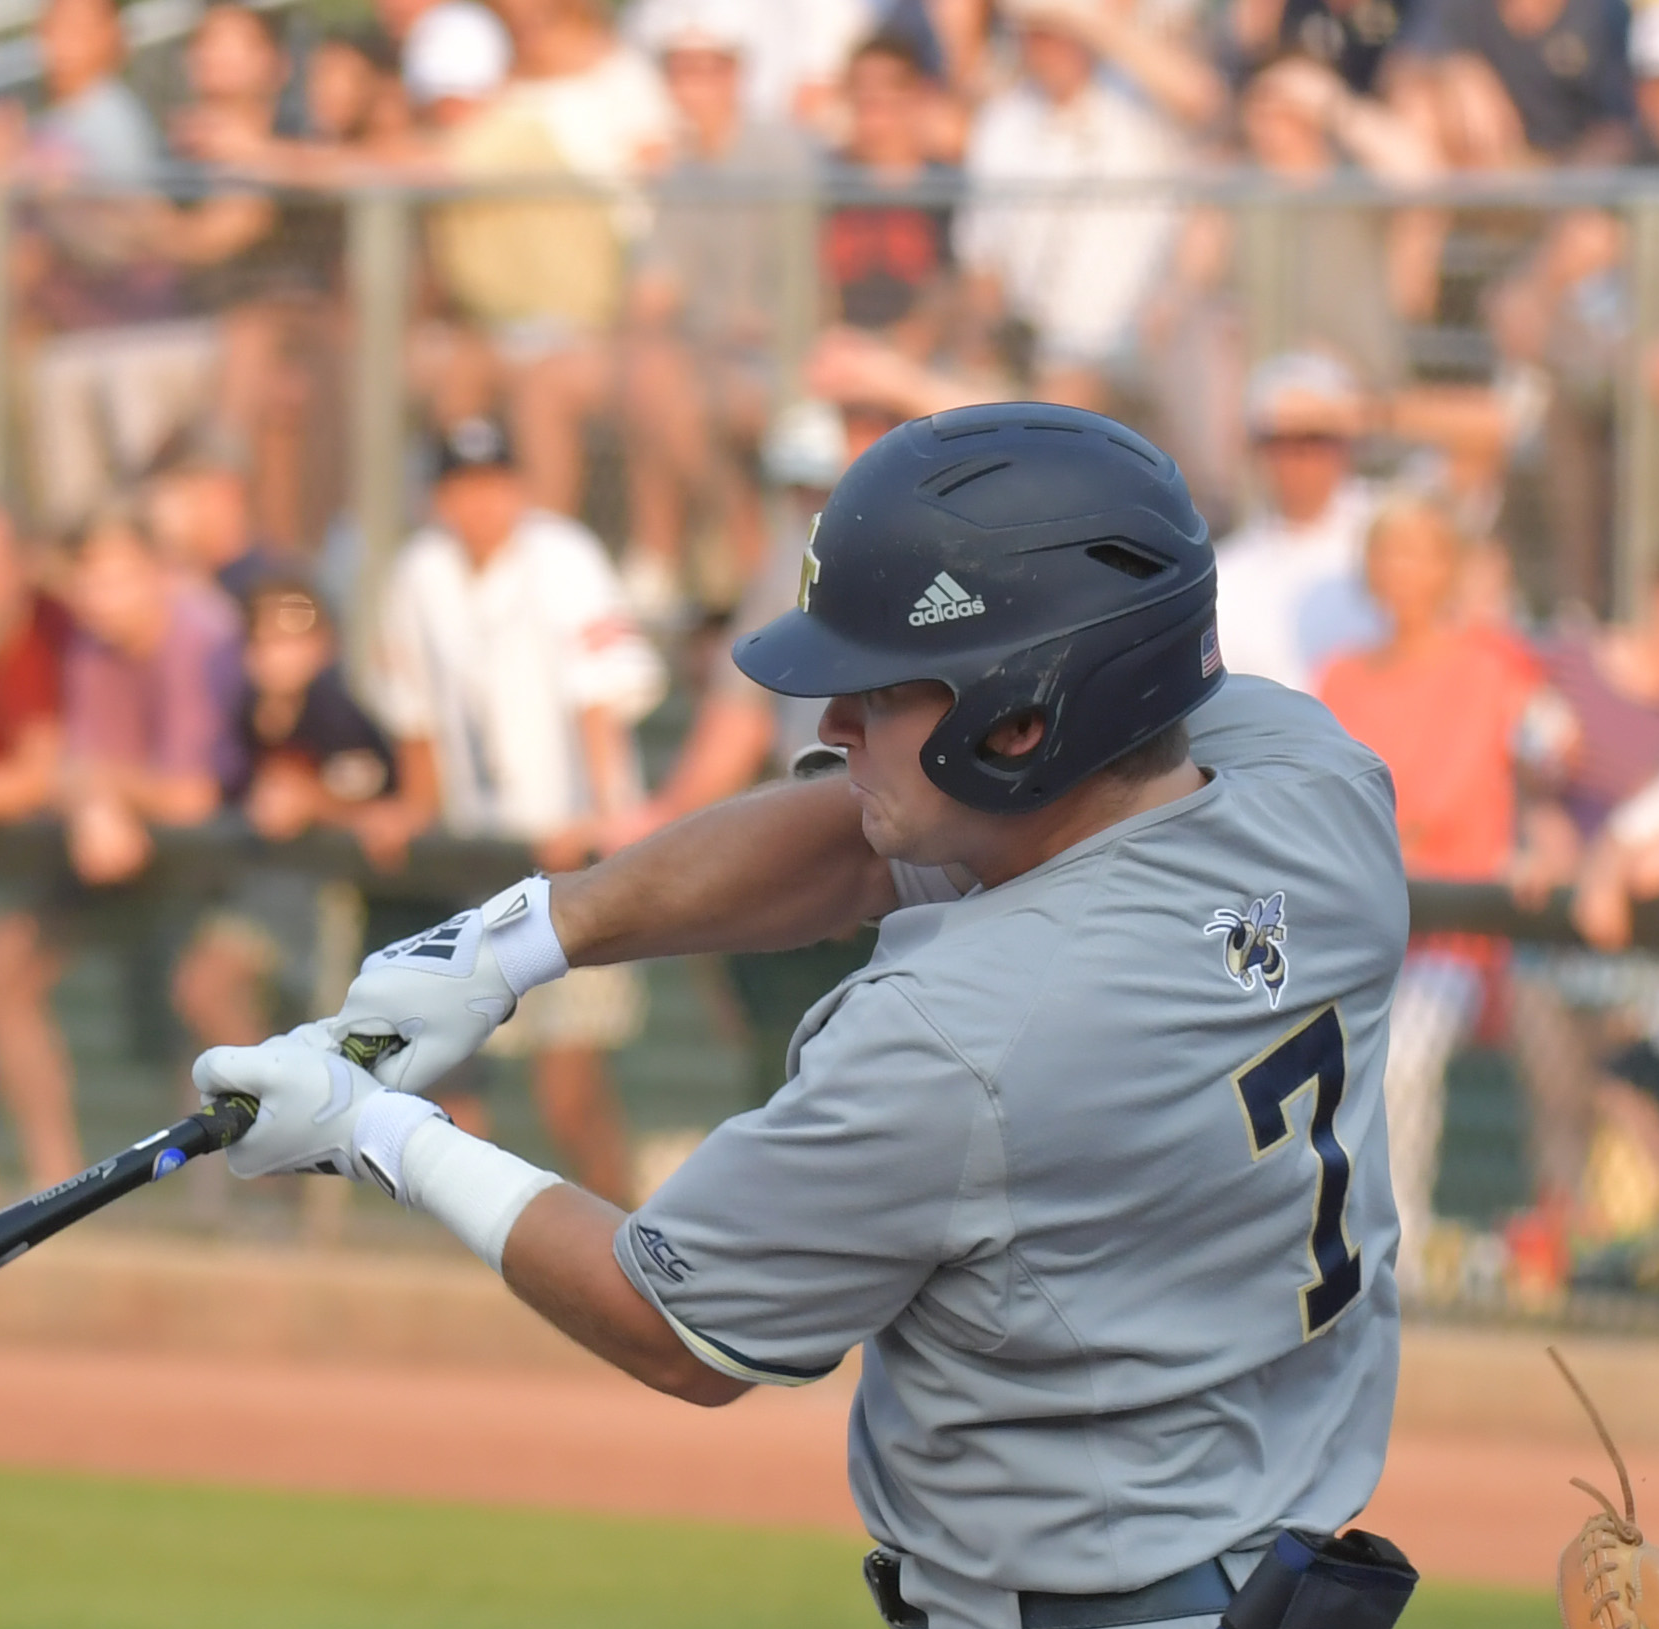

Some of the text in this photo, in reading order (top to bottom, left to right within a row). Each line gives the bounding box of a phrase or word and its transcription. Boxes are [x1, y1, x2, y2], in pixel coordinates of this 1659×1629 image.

[908, 599, 986, 627] adidas
[1230, 1001, 1363, 1343] 7
[637, 1224, 696, 1284] ACC
